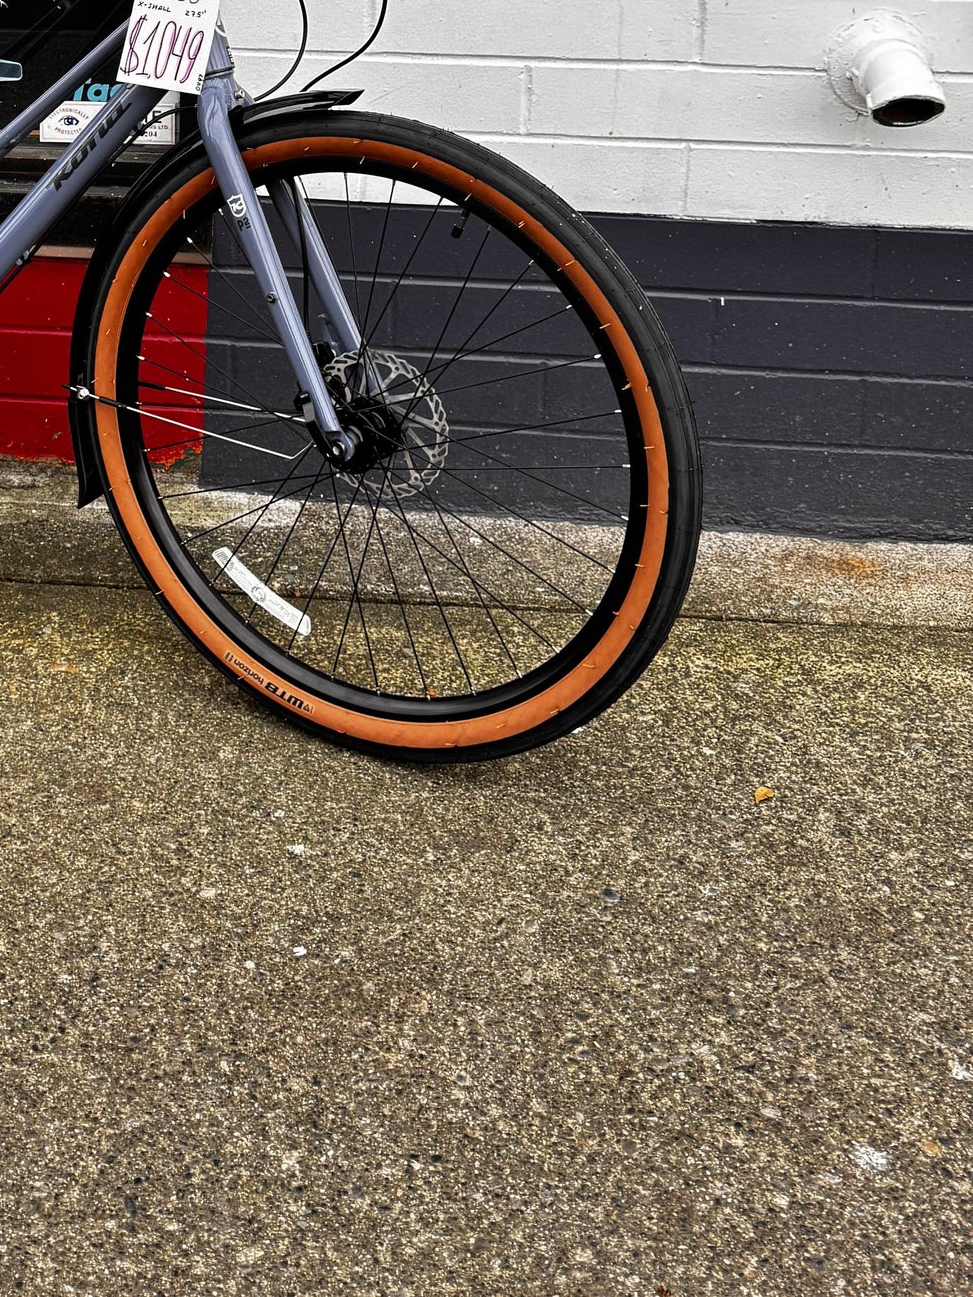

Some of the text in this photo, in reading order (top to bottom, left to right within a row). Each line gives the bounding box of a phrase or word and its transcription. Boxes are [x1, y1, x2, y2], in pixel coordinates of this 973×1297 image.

[120, 14, 205, 84] $1,049
[233, 658, 308, 710] WTB horizon
